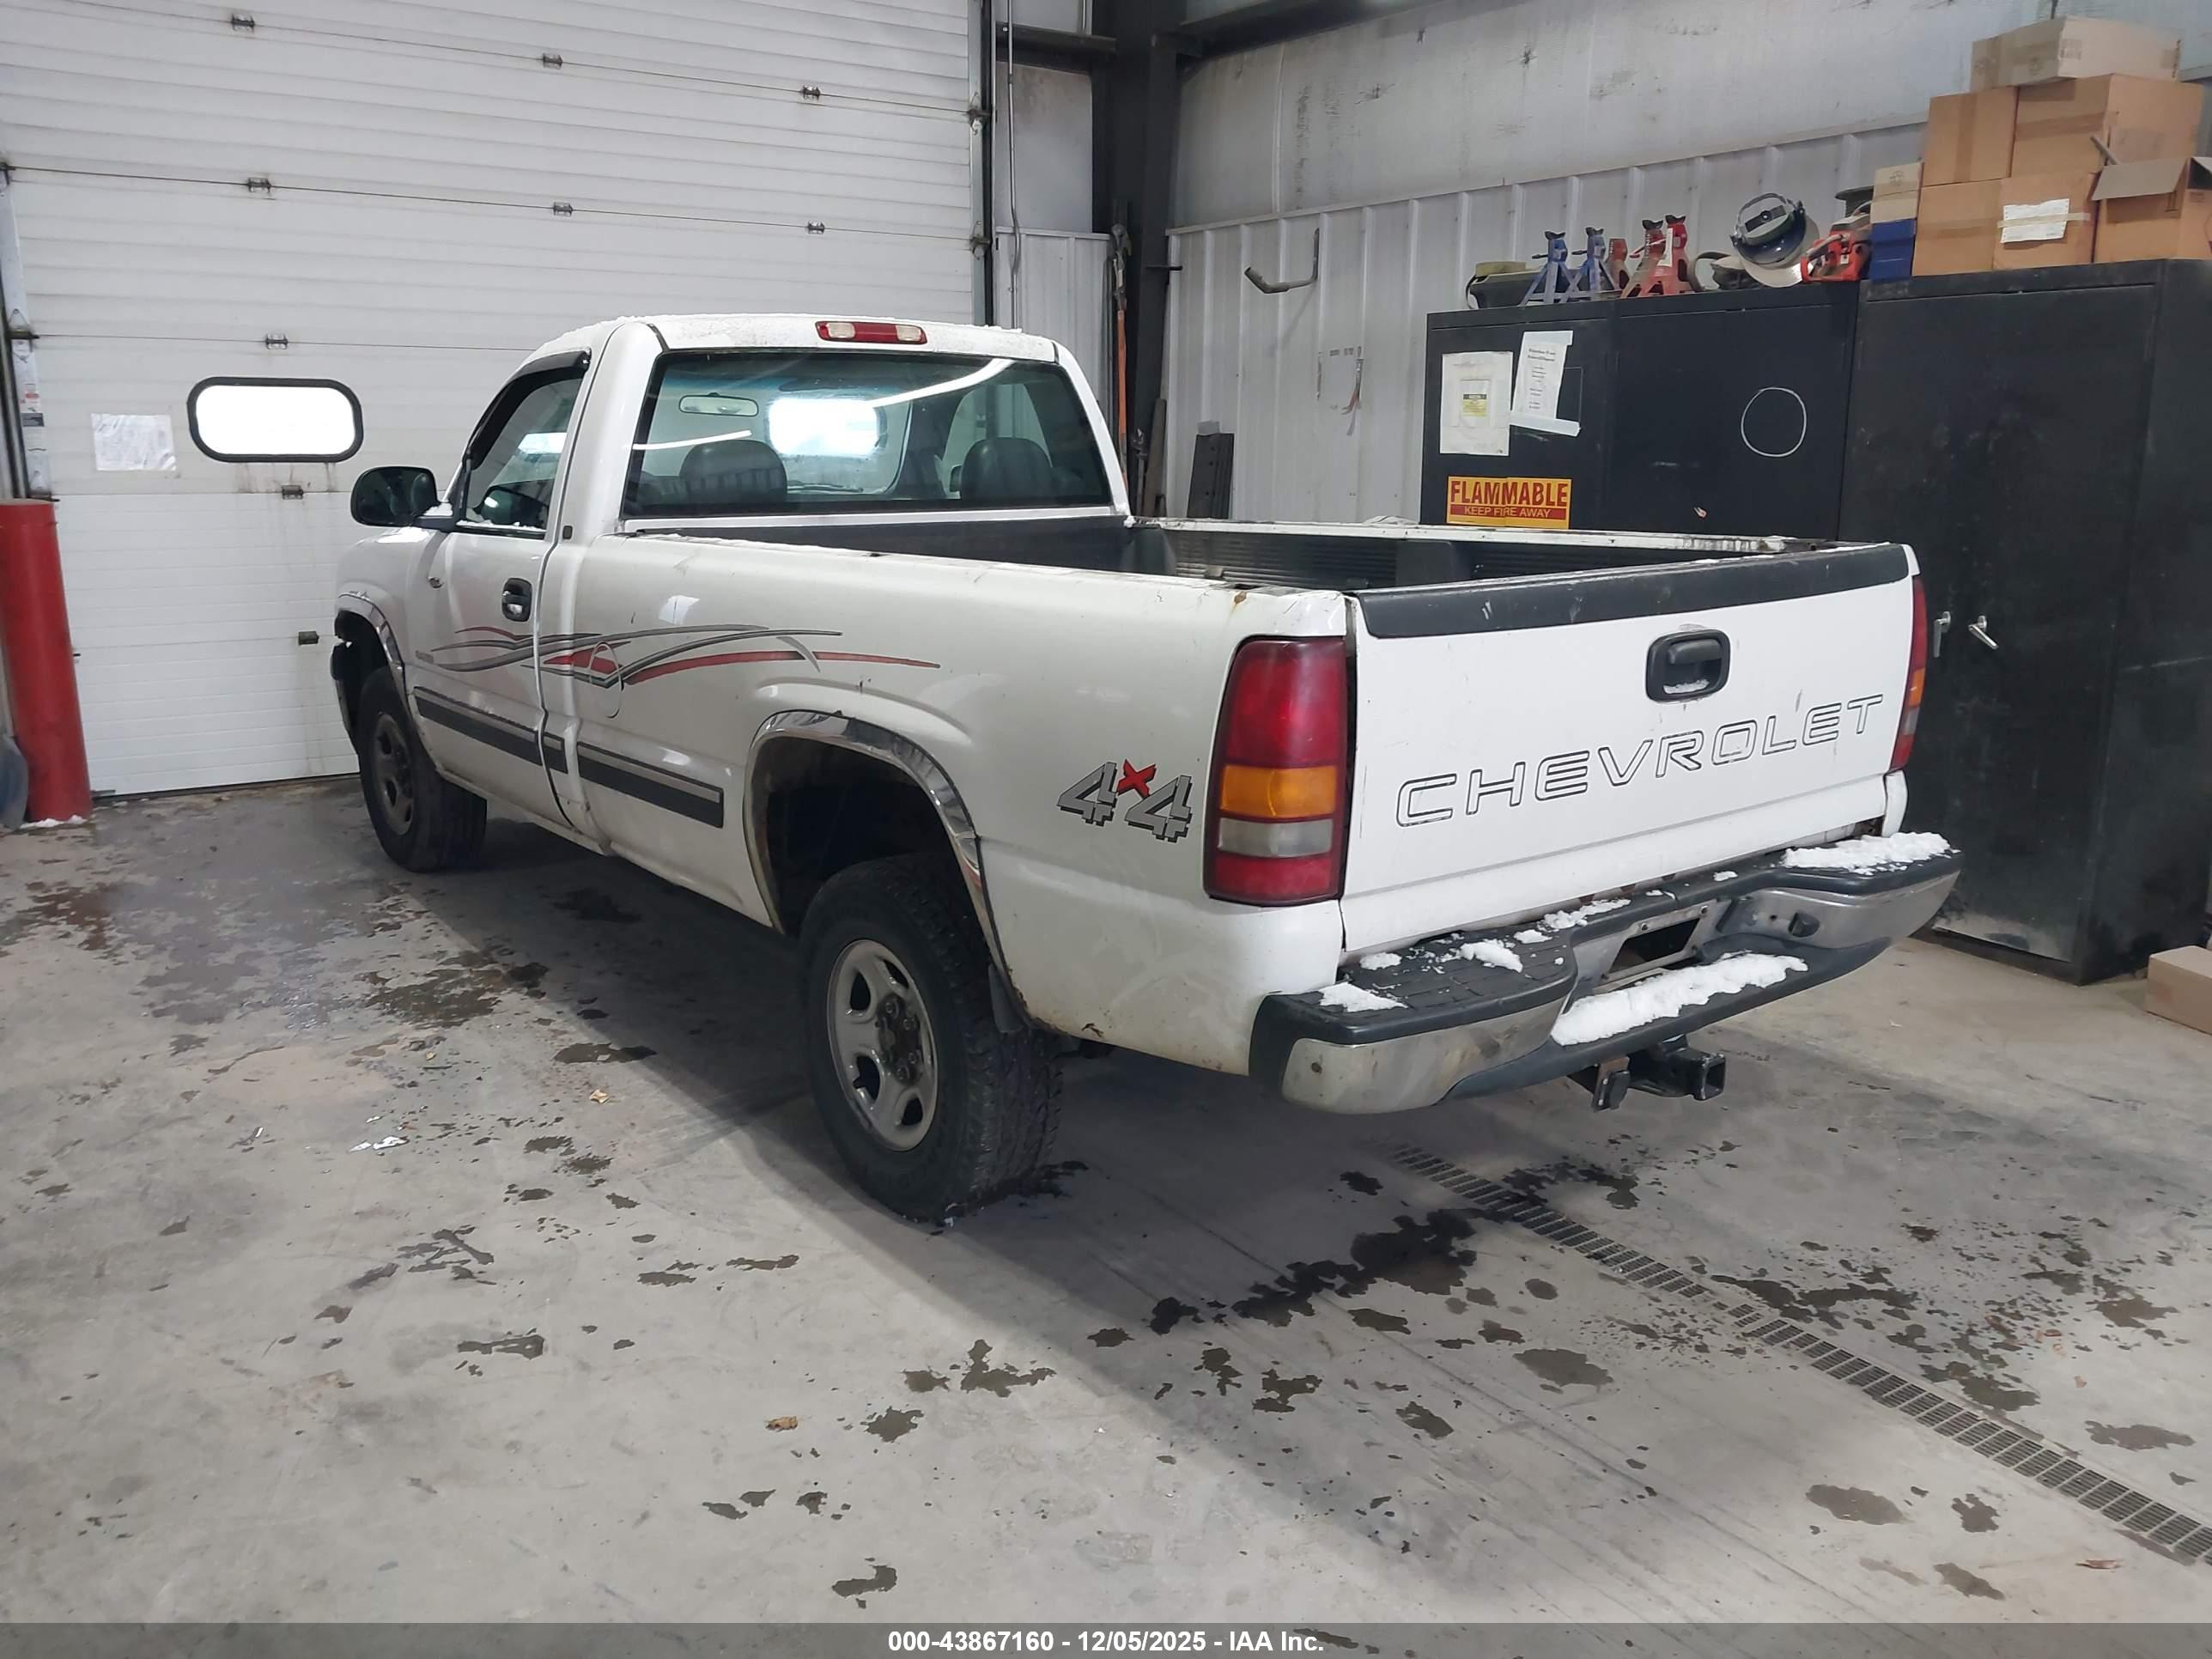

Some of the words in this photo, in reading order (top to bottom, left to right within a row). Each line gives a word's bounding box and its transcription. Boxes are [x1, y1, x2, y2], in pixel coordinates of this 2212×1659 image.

[1450, 480, 1569, 507] FLAMMABLE
[1464, 506, 1492, 515] KEEP
[1495, 507, 1516, 517] FIRE
[1519, 508, 1552, 518] AWAY
[1396, 694, 1883, 827] CHEVROLET
